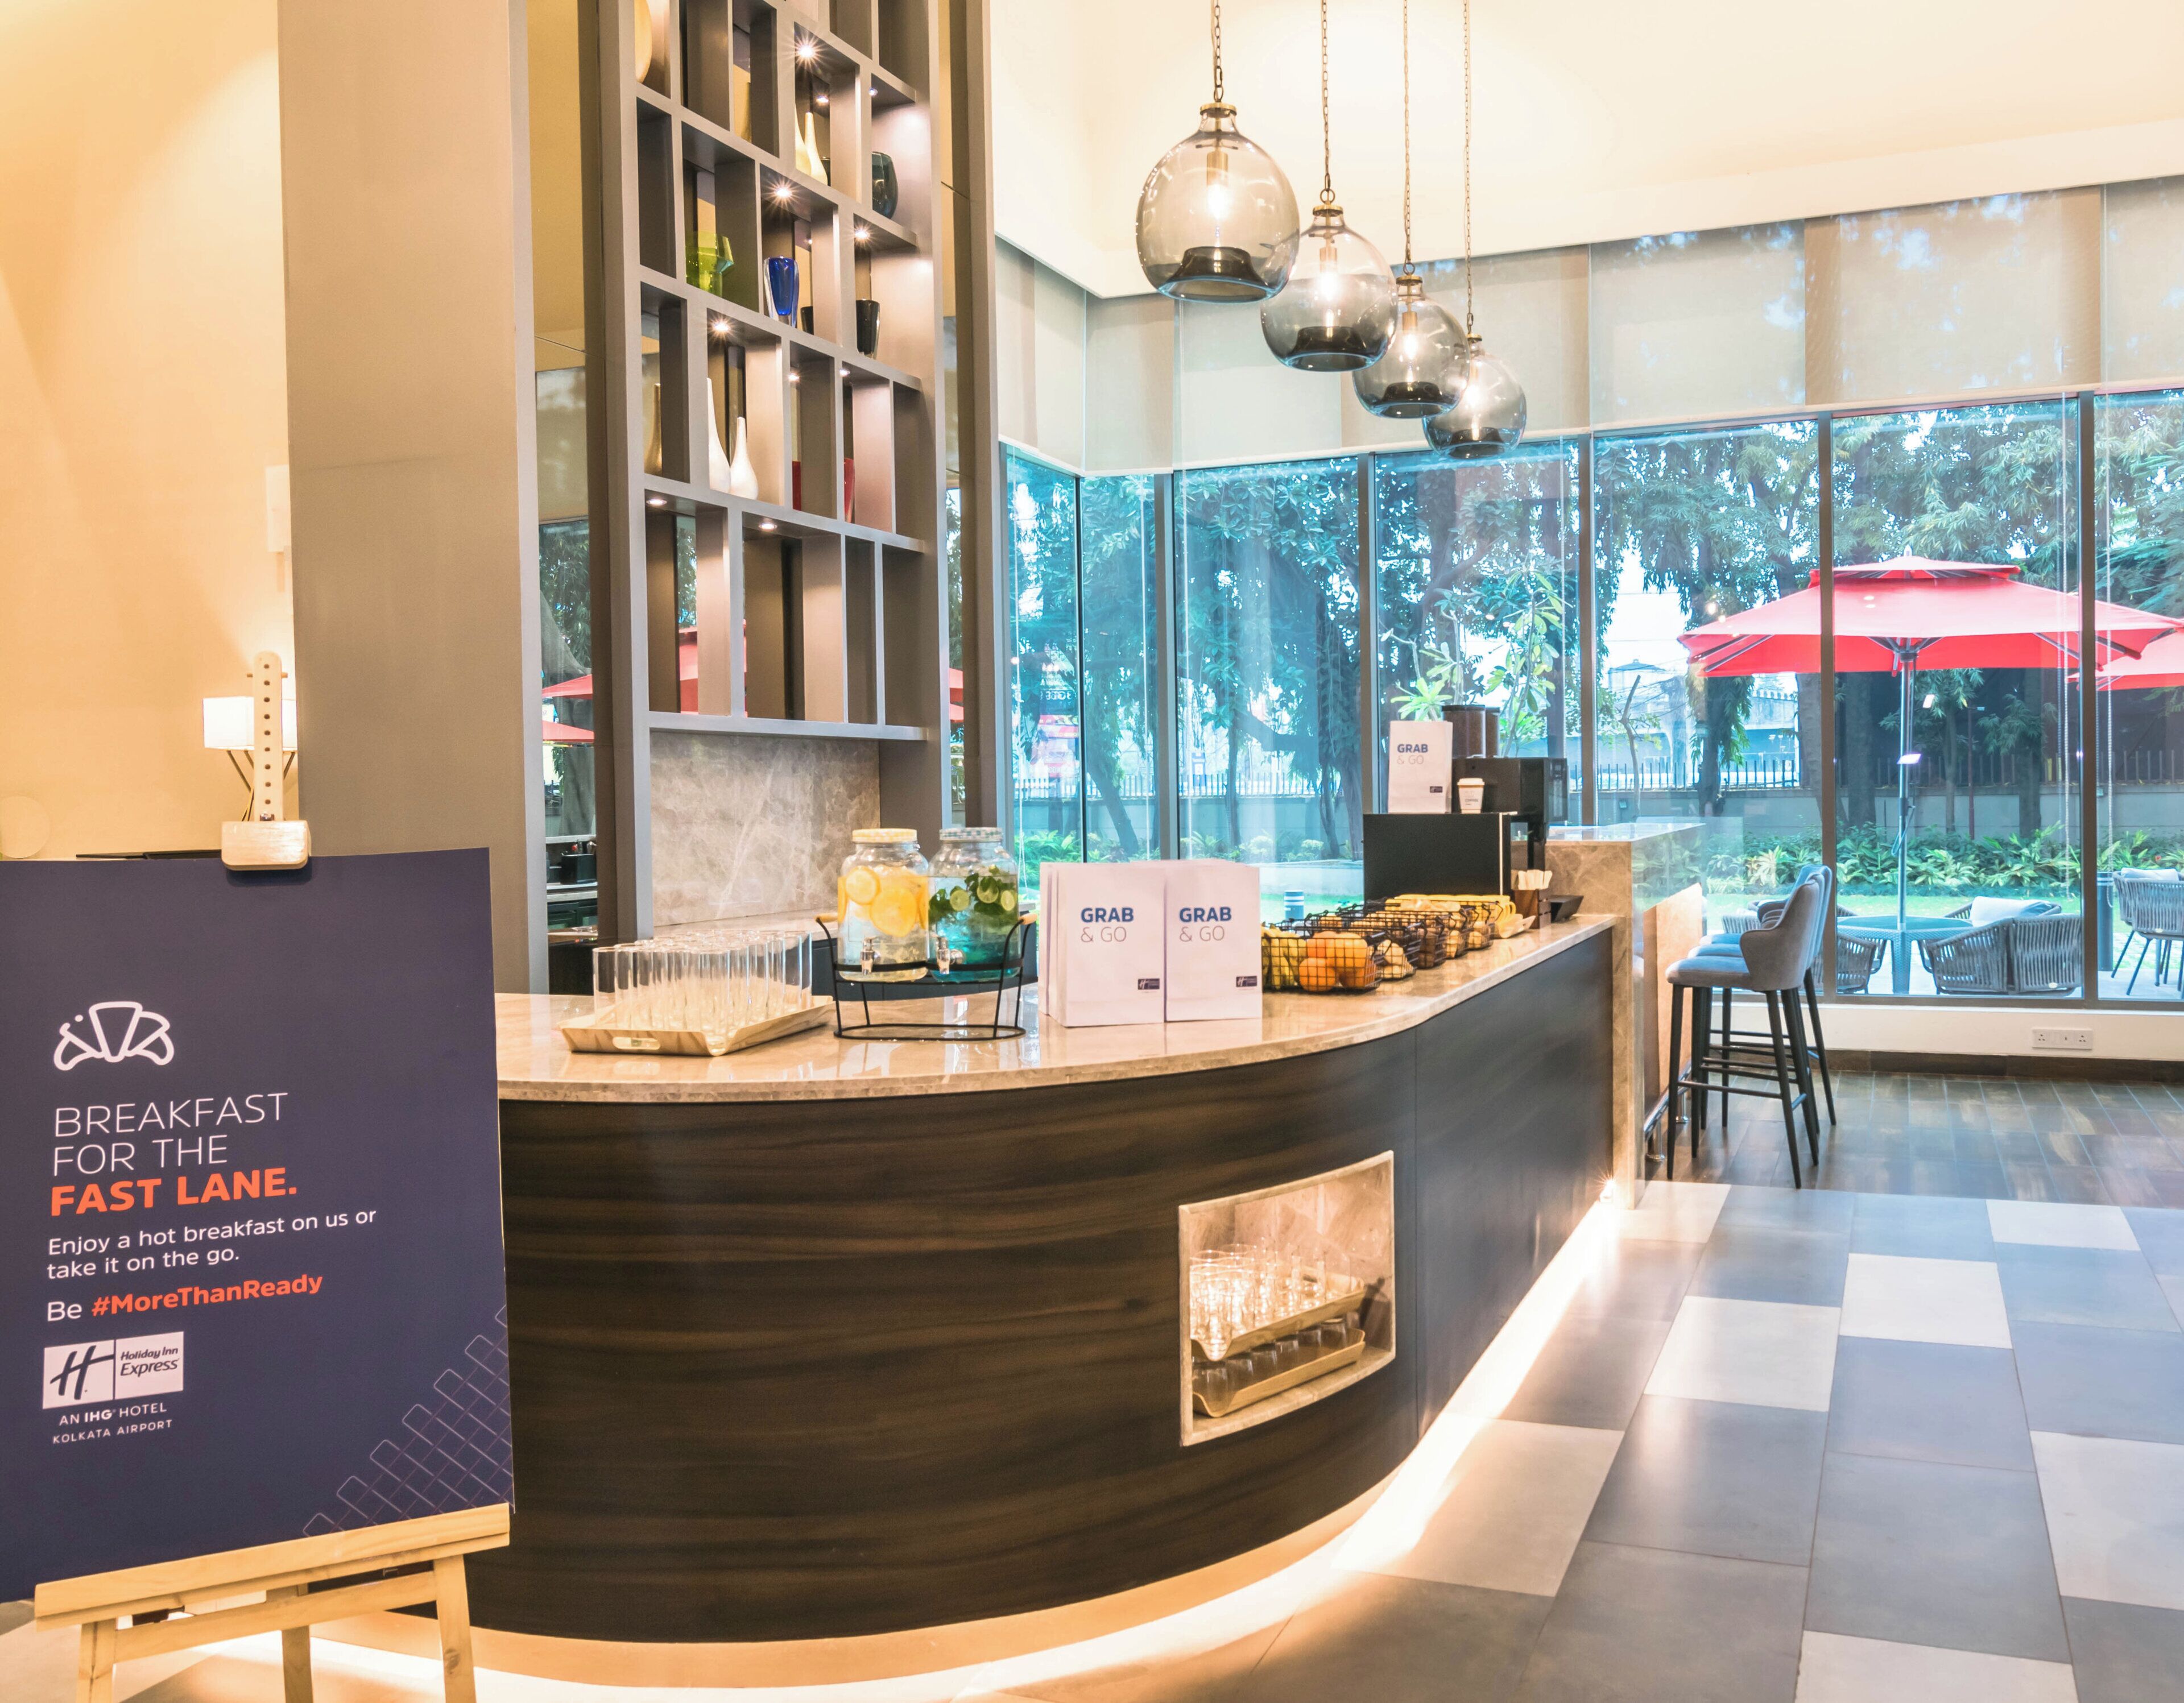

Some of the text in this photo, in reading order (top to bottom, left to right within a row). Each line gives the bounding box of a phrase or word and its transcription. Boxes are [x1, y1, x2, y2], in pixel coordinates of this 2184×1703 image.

[1397, 744, 1428, 753] GRAB
[1397, 755, 1424, 764] & GO
[1081, 907, 1134, 923] GRAB
[1179, 906, 1232, 922] GRAB
[1081, 926, 1127, 943] & GO
[1179, 926, 1225, 942] & GO
[55, 1092, 288, 1137] BREAKFAST
[54, 1134, 228, 1176] FOR THE
[51, 1167, 297, 1216] FAST LANE.
[49, 1211, 377, 1256] Enjoy a hot breakfast on us or
[47, 1248, 239, 1279] take it on the go.
[47, 1274, 323, 1321] Be #MoreThanReady
[121, 1346, 178, 1361] Holiday Inn
[120, 1358, 178, 1377] Express
[59, 1402, 167, 1426] AN IHG HOTEL
[53, 1419, 172, 1444] KOLKATA AIRPORT
